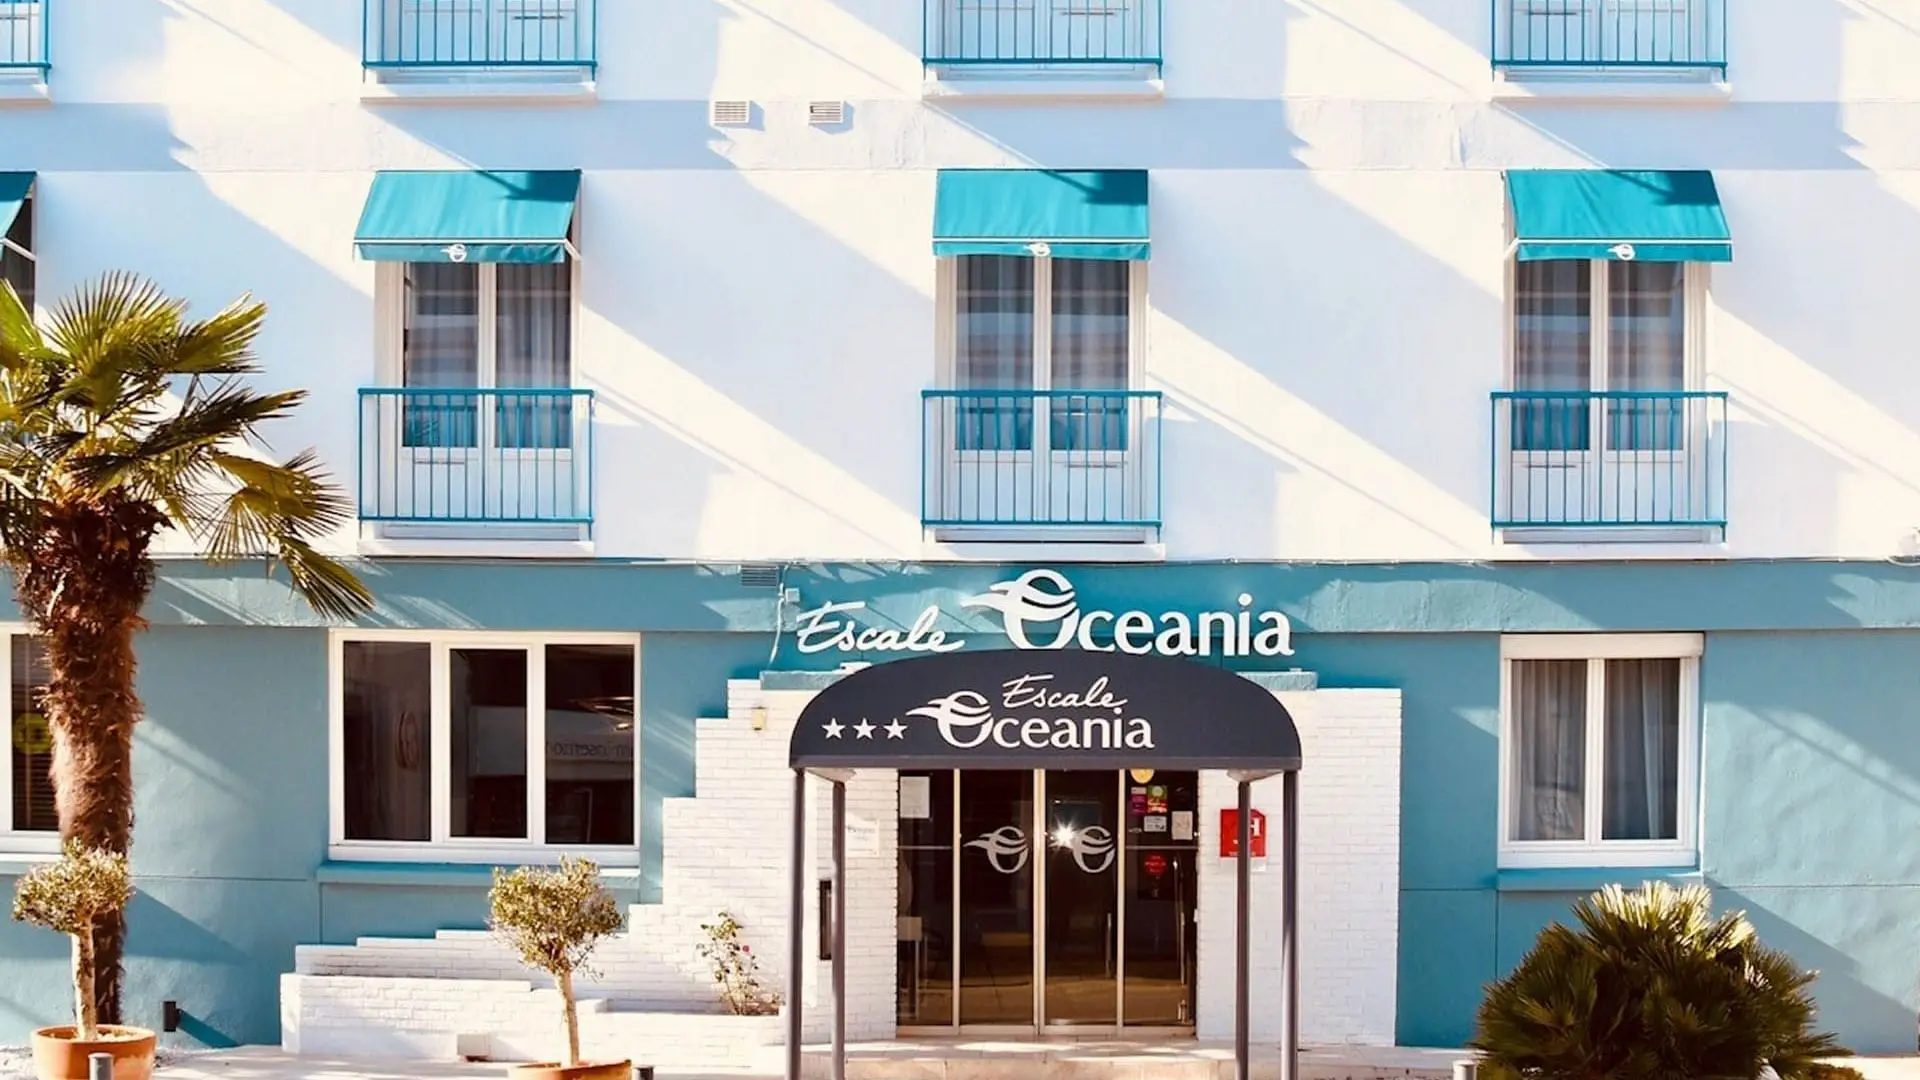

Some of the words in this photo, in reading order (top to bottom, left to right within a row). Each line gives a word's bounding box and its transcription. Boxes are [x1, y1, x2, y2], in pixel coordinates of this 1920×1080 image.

[796, 600, 966, 653] Escale
[962, 569, 1296, 656] Oceania
[906, 690, 1155, 748] Oceania
[1002, 674, 1128, 708] Escale
